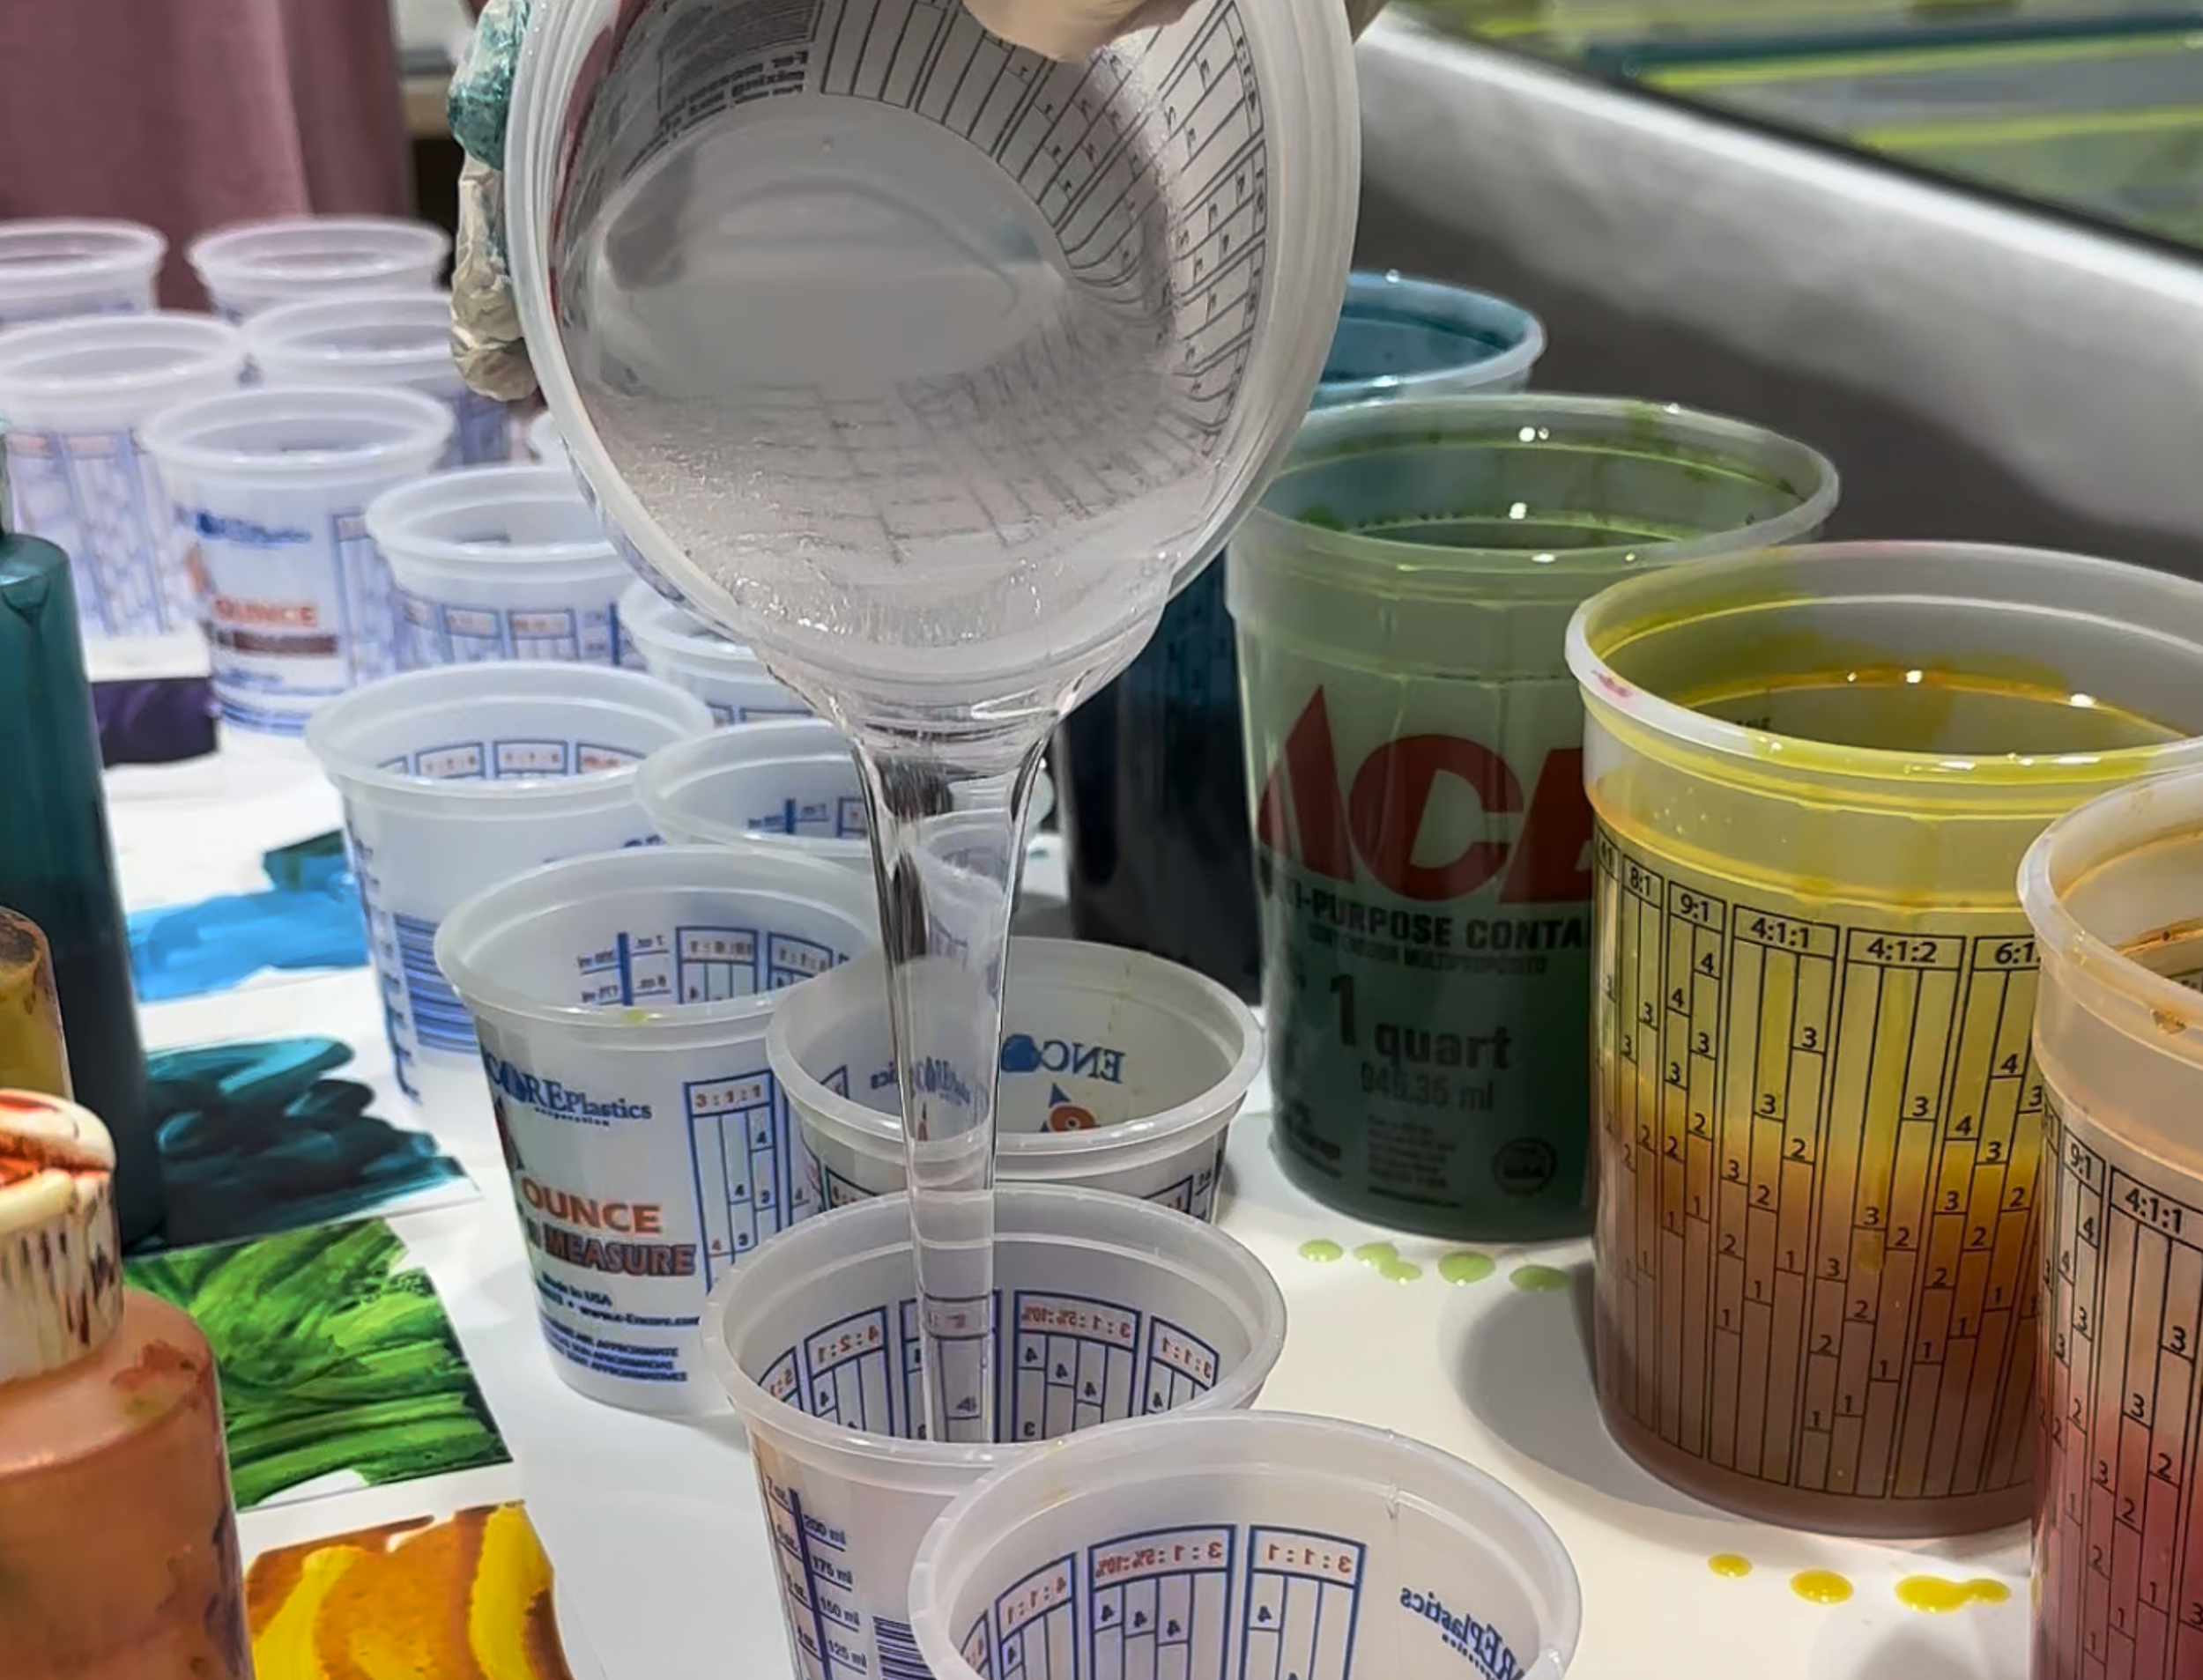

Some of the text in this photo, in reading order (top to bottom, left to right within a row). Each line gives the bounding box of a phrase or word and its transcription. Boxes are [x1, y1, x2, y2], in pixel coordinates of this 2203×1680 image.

[1630, 867, 1650, 896] 8:1
[1680, 893, 1709, 922] 9:1
[1750, 917, 1811, 950] 4:1:1
[1866, 937, 1938, 964] 4:1:2
[1701, 952, 1714, 973] 4
[1672, 988, 1684, 1008] 4
[1329, 973, 1512, 1071] 1 quart
[1644, 1002, 1653, 1024] 3
[1623, 1034, 1632, 1056] 3
[1698, 1032, 1710, 1054] 3
[1803, 1028, 1817, 1048] 3
[1670, 1062, 1680, 1084] 3
[2000, 1053, 2018, 1074] 4
[1459, 1080, 1495, 1112] ml
[1762, 1096, 1776, 1115] 3
[1913, 1096, 1929, 1116] 3
[1694, 1113, 1706, 1135] 2
[1955, 1115, 1972, 1136] 4
[1641, 1124, 1650, 1146] 2
[1668, 1136, 1678, 1158] 2
[1792, 1139, 1806, 1158] 2
[1985, 1141, 2001, 1162] 3
[1727, 1160, 1740, 1180] 3
[2071, 1143, 2092, 1180] 9:1
[521, 1177, 662, 1234] OUNCE
[1693, 1195, 1700, 1216] 1
[1756, 1186, 1770, 1206] 2
[1944, 1191, 1959, 1210] 3
[2009, 1187, 2025, 1208] 2
[1864, 1207, 1880, 1226] 3
[2125, 1186, 2184, 1234] 4:1:1
[1669, 1211, 1674, 1231] 1
[2083, 1217, 2095, 1240] 4
[1724, 1234, 1737, 1254] 2
[1896, 1228, 1910, 1247] 2
[1971, 1227, 1986, 1247] 2
[540, 1221, 697, 1277] MEASURE
[1786, 1250, 1794, 1269] 1
[1827, 1258, 1840, 1277] 3
[2062, 1250, 2070, 1272] 4
[1932, 1268, 1947, 1287] 2
[583, 1289, 612, 1307] USA
[1754, 1280, 1762, 1299] 1
[1995, 1286, 2002, 1306] 1
[1723, 1308, 1730, 1328] 1
[1854, 1300, 1869, 1319] 2
[2079, 1306, 2088, 1332] 3
[1959, 1316, 1967, 1337] 1
[1819, 1335, 1833, 1354] 2
[2058, 1333, 2066, 1359] 3
[2171, 1326, 2187, 1354] 3
[1923, 1342, 1931, 1360] 1
[1880, 1360, 1888, 1379] 1
[1844, 1395, 1851, 1413] 1
[2072, 1397, 2082, 1425] 2
[2131, 1392, 2145, 1419] 3
[1812, 1410, 1820, 1429] 1
[2099, 1459, 2109, 1485] 3
[2158, 1452, 2173, 1481] 2
[2121, 1497, 2136, 1524] 2
[812, 1555, 834, 1576] 175
[2093, 1544, 2103, 1571] 2
[2149, 1581, 2157, 1603] 1
[820, 1595, 842, 1617] 150
[2118, 1607, 2125, 1628] 1
[827, 1639, 849, 1660] 125
[2091, 1631, 2096, 1653] 1
